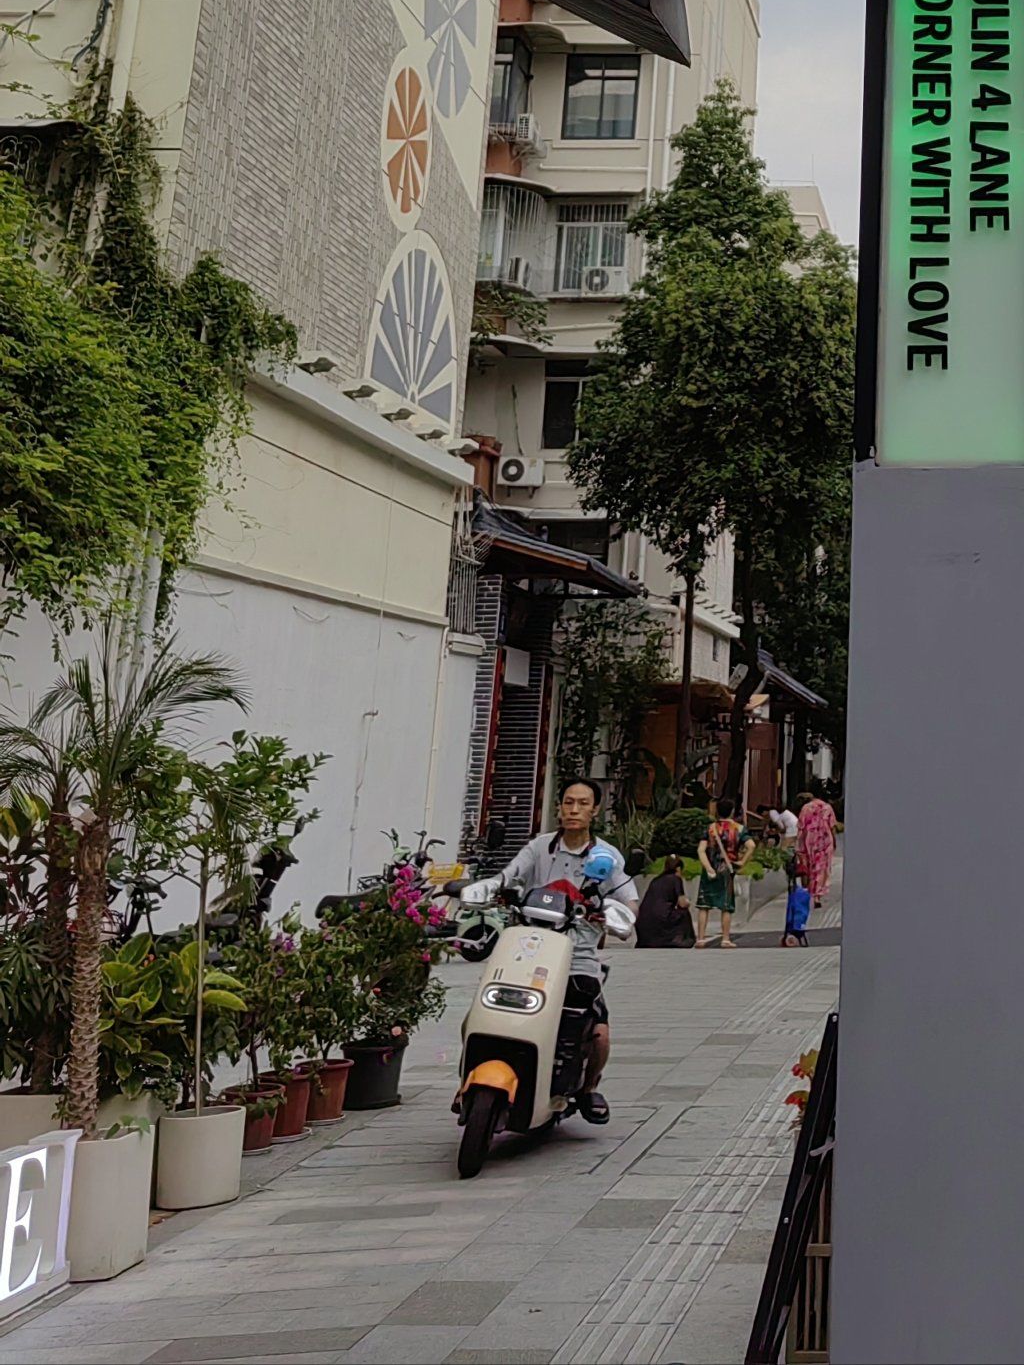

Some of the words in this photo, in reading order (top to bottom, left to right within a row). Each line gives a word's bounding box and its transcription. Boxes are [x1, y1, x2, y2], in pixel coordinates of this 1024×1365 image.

[970, 83, 1012, 112] 4
[909, 136, 952, 243] WITH
[969, 121, 1012, 232] LANE
[906, 257, 950, 371] LOVE
